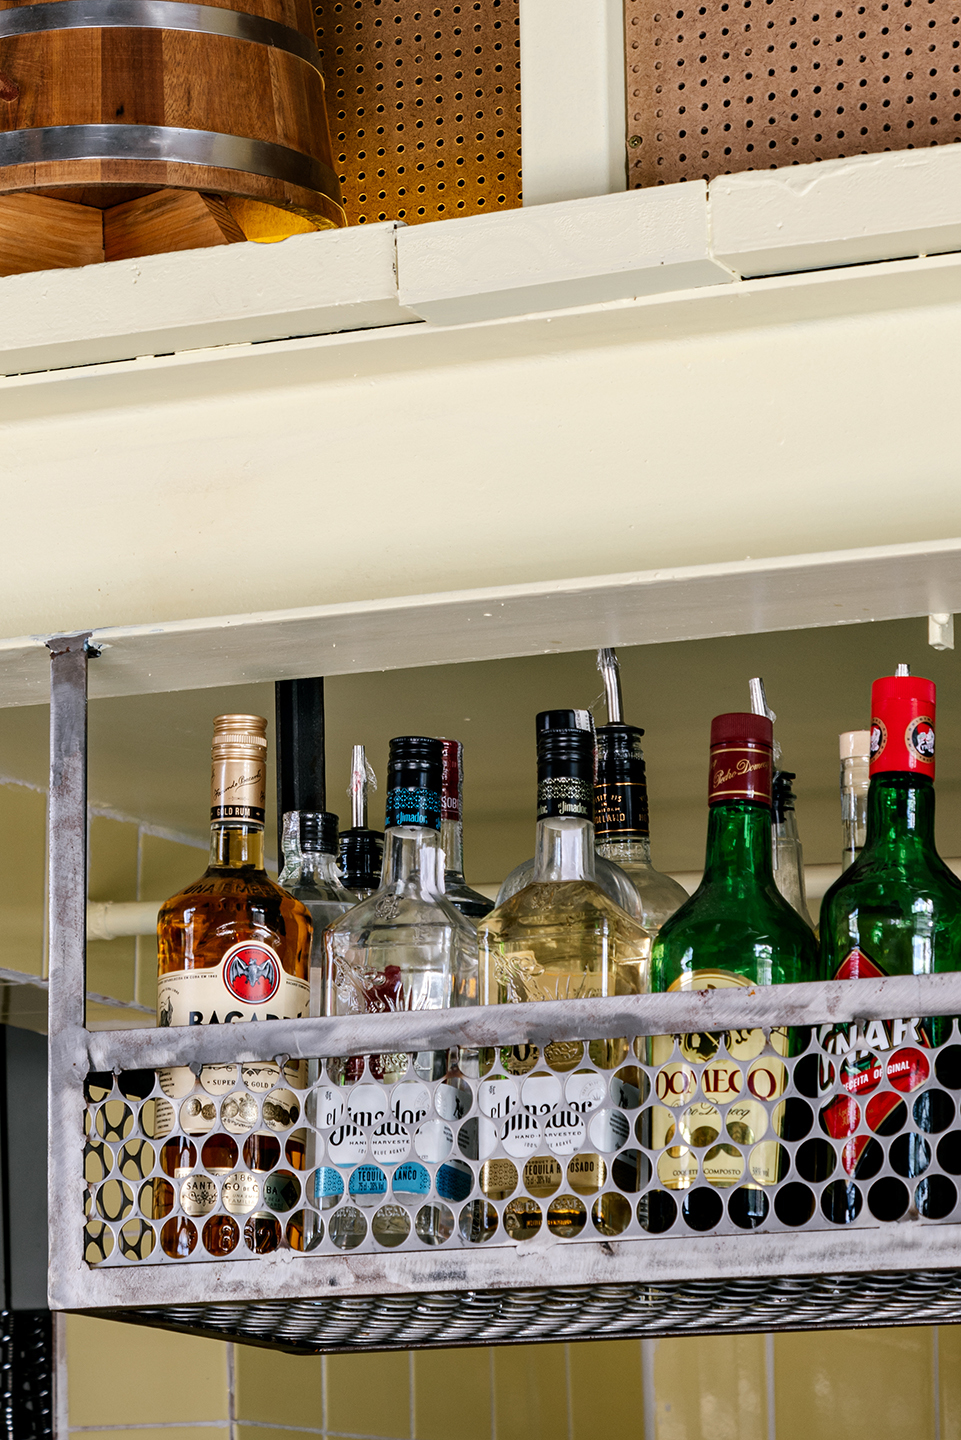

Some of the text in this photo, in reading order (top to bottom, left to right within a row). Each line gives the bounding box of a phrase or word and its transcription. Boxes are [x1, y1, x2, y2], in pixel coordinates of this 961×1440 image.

[441, 796, 458, 809] SOB
[216, 807, 251, 816] GOLD RUM
[873, 1060, 910, 1079] ORGINAL
[389, 1147, 406, 1155] AGAVE
[525, 1161, 595, 1175] TEQUILA ROSADO
[704, 1168, 741, 1176] COMPOSTO
[234, 1173, 257, 1182] 186
[358, 1169, 417, 1182] TEQUILA LANCO
[186, 1182, 240, 1191] SANTGO
[252, 1185, 278, 1196] CBA
